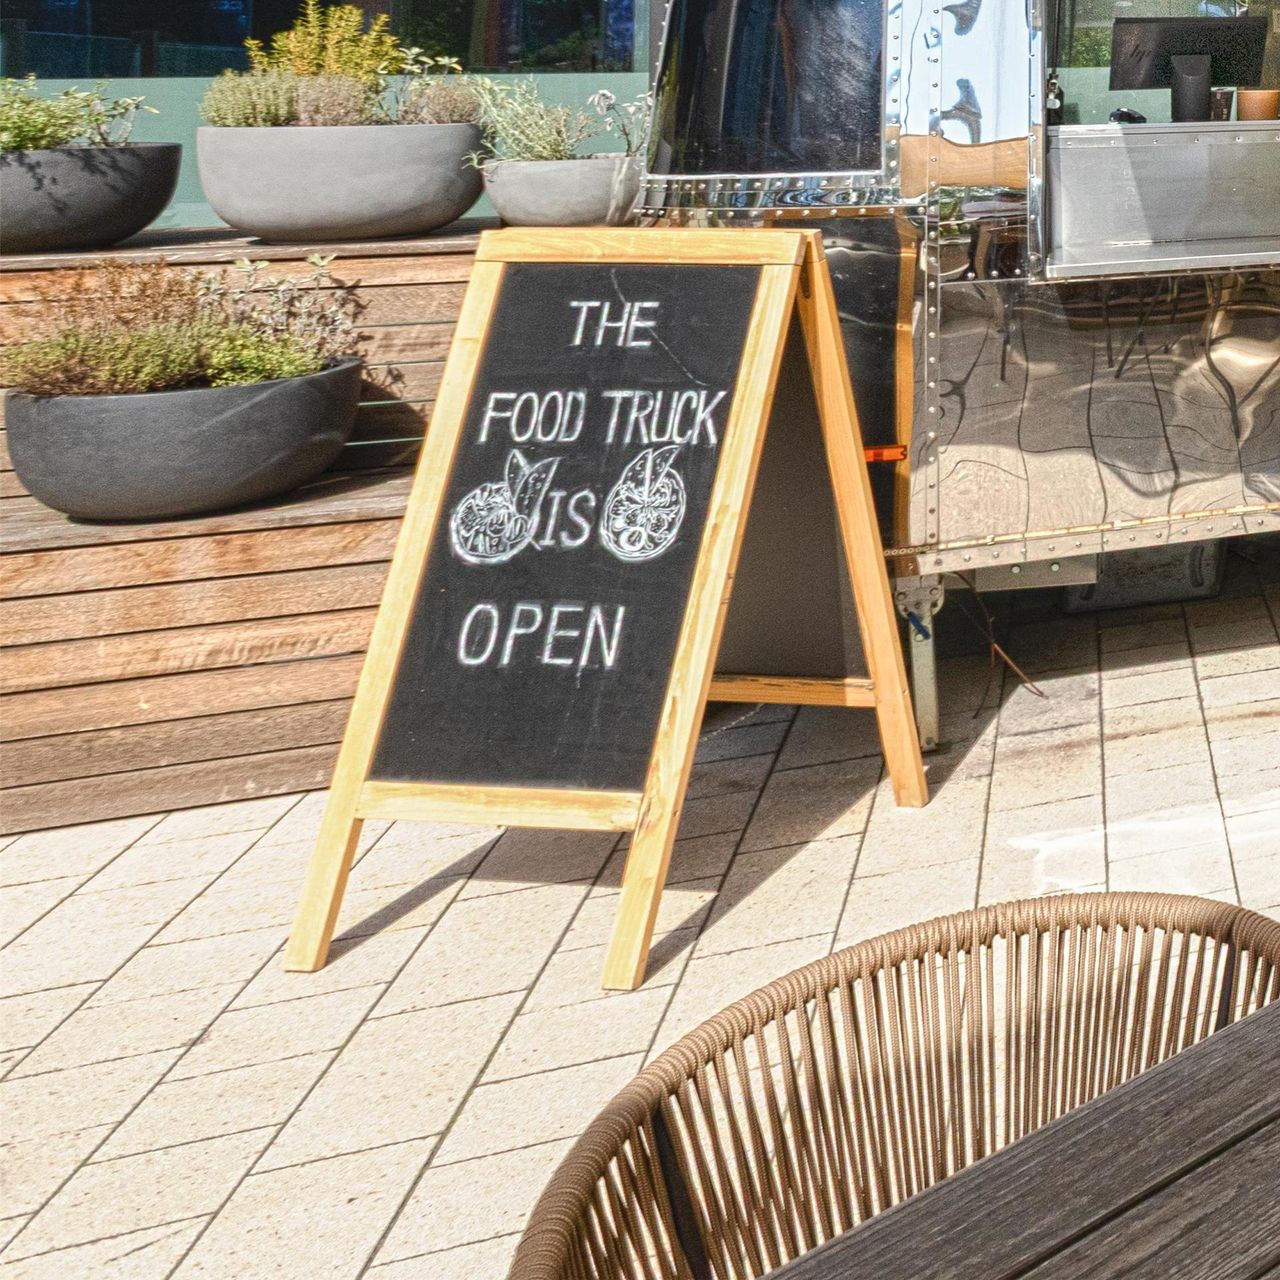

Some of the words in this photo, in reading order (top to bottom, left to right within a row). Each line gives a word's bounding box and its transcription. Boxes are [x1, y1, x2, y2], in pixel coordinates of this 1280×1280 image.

[570, 300, 660, 348] THE
[477, 389, 587, 445] FOOD
[602, 389, 728, 445] TRUCK
[539, 488, 597, 549] IS
[457, 602, 626, 667] OPEN
